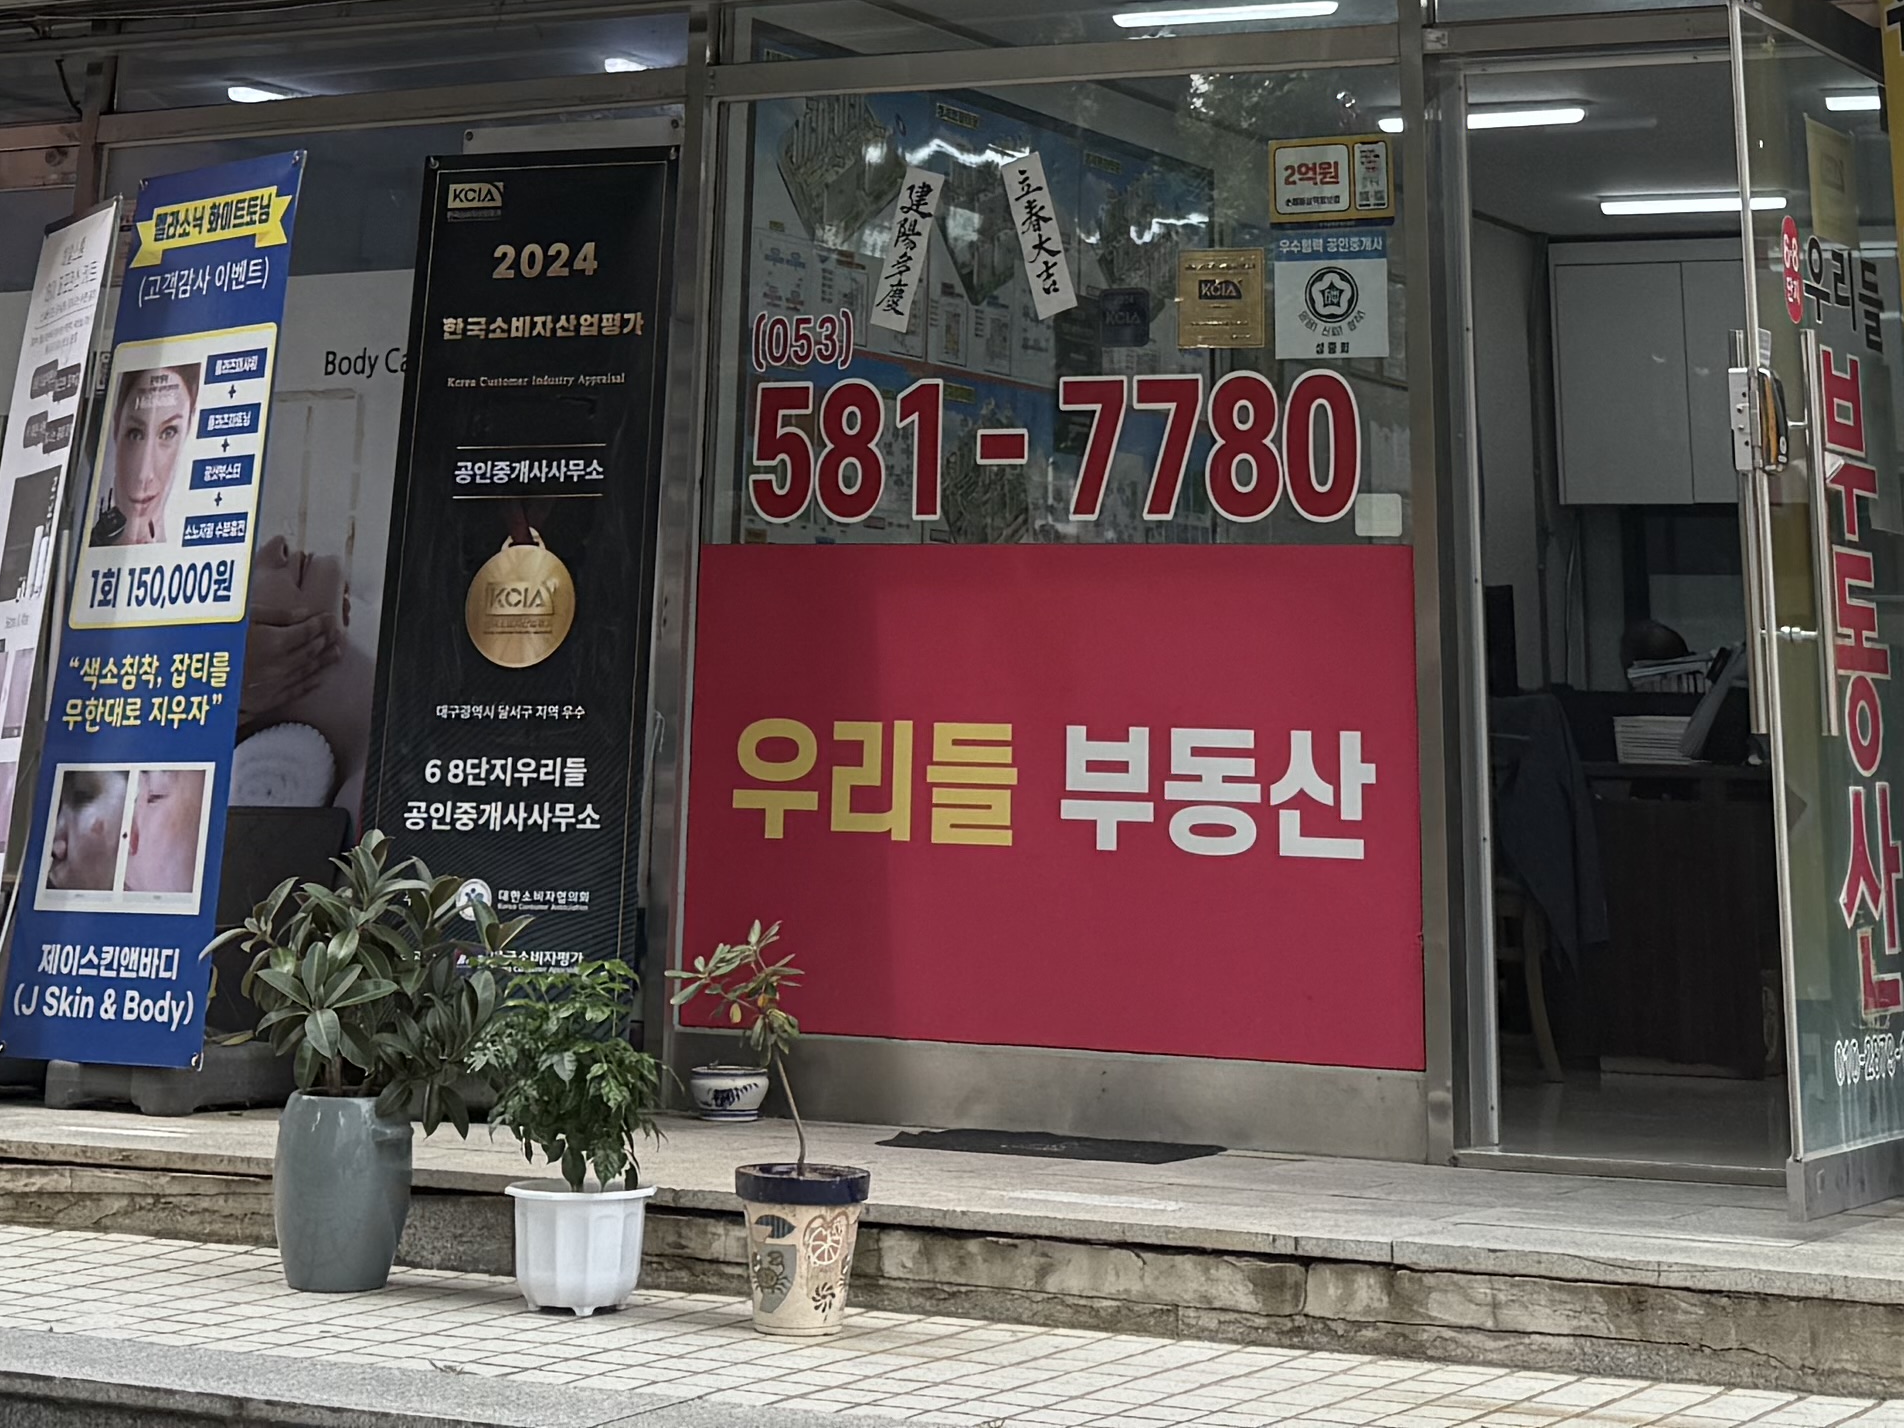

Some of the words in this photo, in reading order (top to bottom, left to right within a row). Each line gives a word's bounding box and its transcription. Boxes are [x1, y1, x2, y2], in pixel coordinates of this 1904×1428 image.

[1289, 154, 1346, 190] 2억원
[876, 183, 933, 316] 建陽多慶
[1014, 169, 1062, 296] 立春大吉
[492, 242, 598, 279] 2024
[138, 268, 210, 308] (고객감사
[216, 257, 270, 290] 이벤트)
[1803, 235, 1885, 353] 우리들
[443, 311, 644, 341] 한국소비자산업평가
[752, 308, 856, 371] (053)
[324, 350, 378, 379] Body
[447, 376, 477, 388] Korea
[453, 460, 604, 485] 공인중개사사무소
[89, 566, 120, 610] 1회
[127, 559, 234, 607] 150,000원
[170, 651, 230, 687] 잡티를
[1818, 343, 1904, 1019] 부동산
[62, 695, 142, 733] 무한대로
[436, 704, 495, 720] 대구광역시
[497, 704, 534, 720] 달서구
[535, 704, 559, 720] 지역
[561, 704, 585, 719] 우수
[731, 717, 1020, 846] 우리들
[1059, 725, 1378, 860] 부동산
[403, 800, 601, 832] 공인중개사사무소
[37, 942, 179, 982] 제이스킨앤바디
[43, 986, 94, 1019] Skin
[122, 988, 195, 1032] Body)
